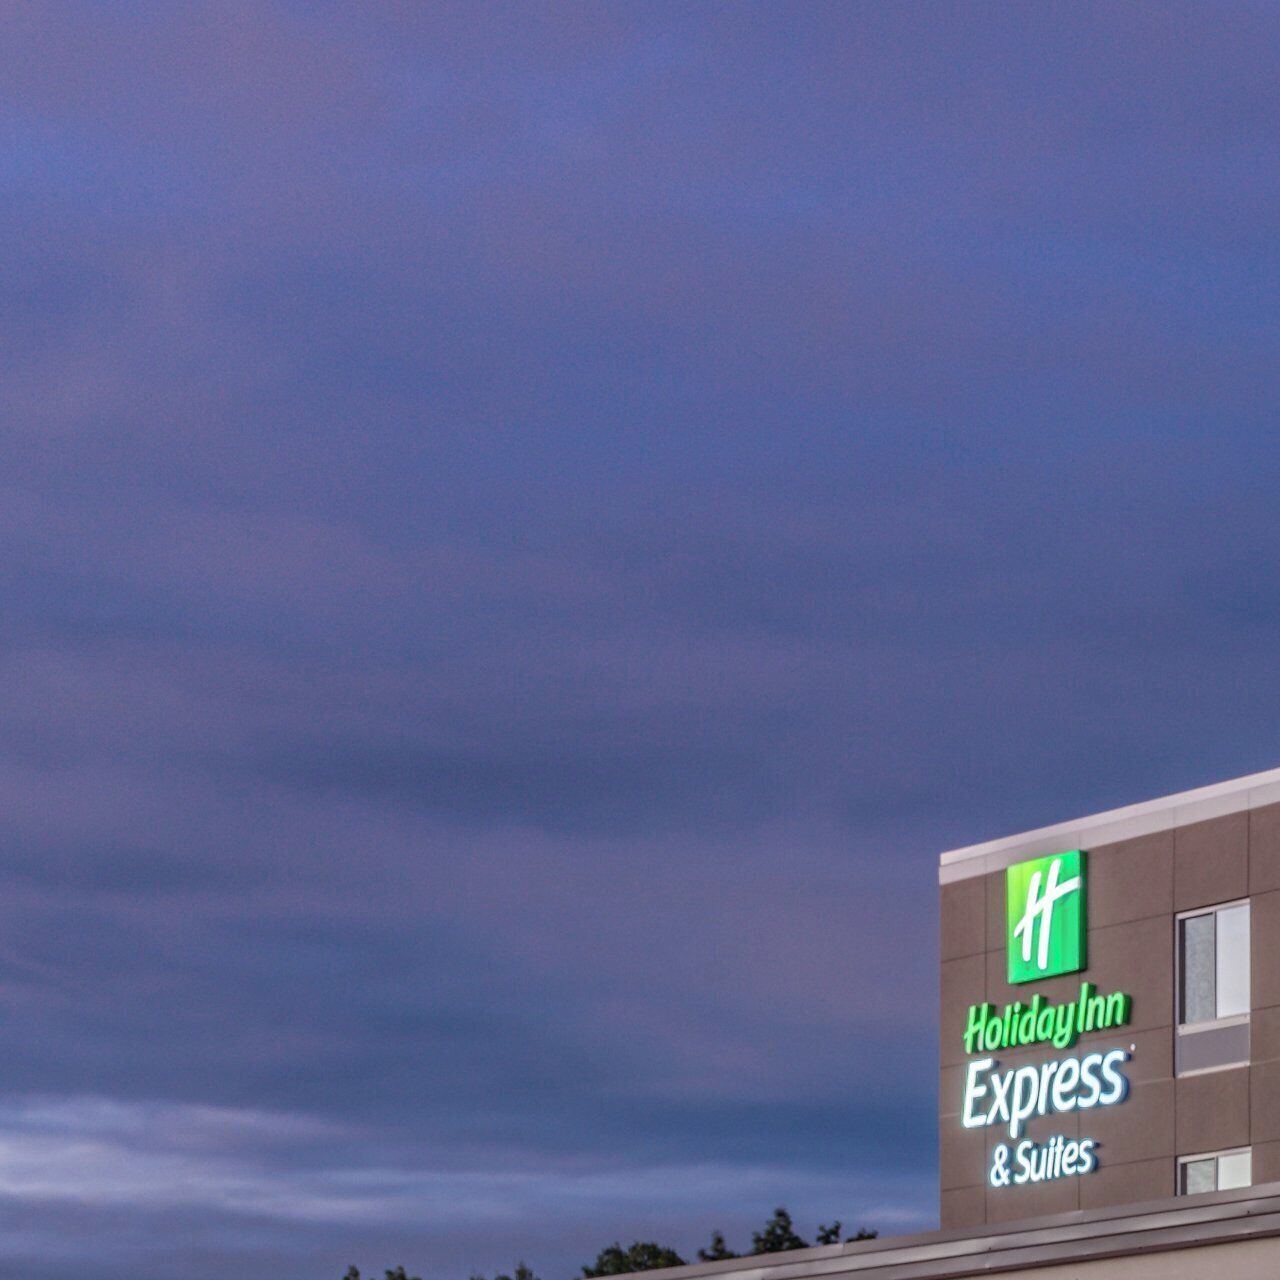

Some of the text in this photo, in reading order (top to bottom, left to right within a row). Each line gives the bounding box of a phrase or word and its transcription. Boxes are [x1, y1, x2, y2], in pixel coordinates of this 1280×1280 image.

[964, 981, 1126, 1054] Holiday Inn
[963, 1049, 1126, 1139] Express
[990, 1135, 1095, 1187] & Suites
